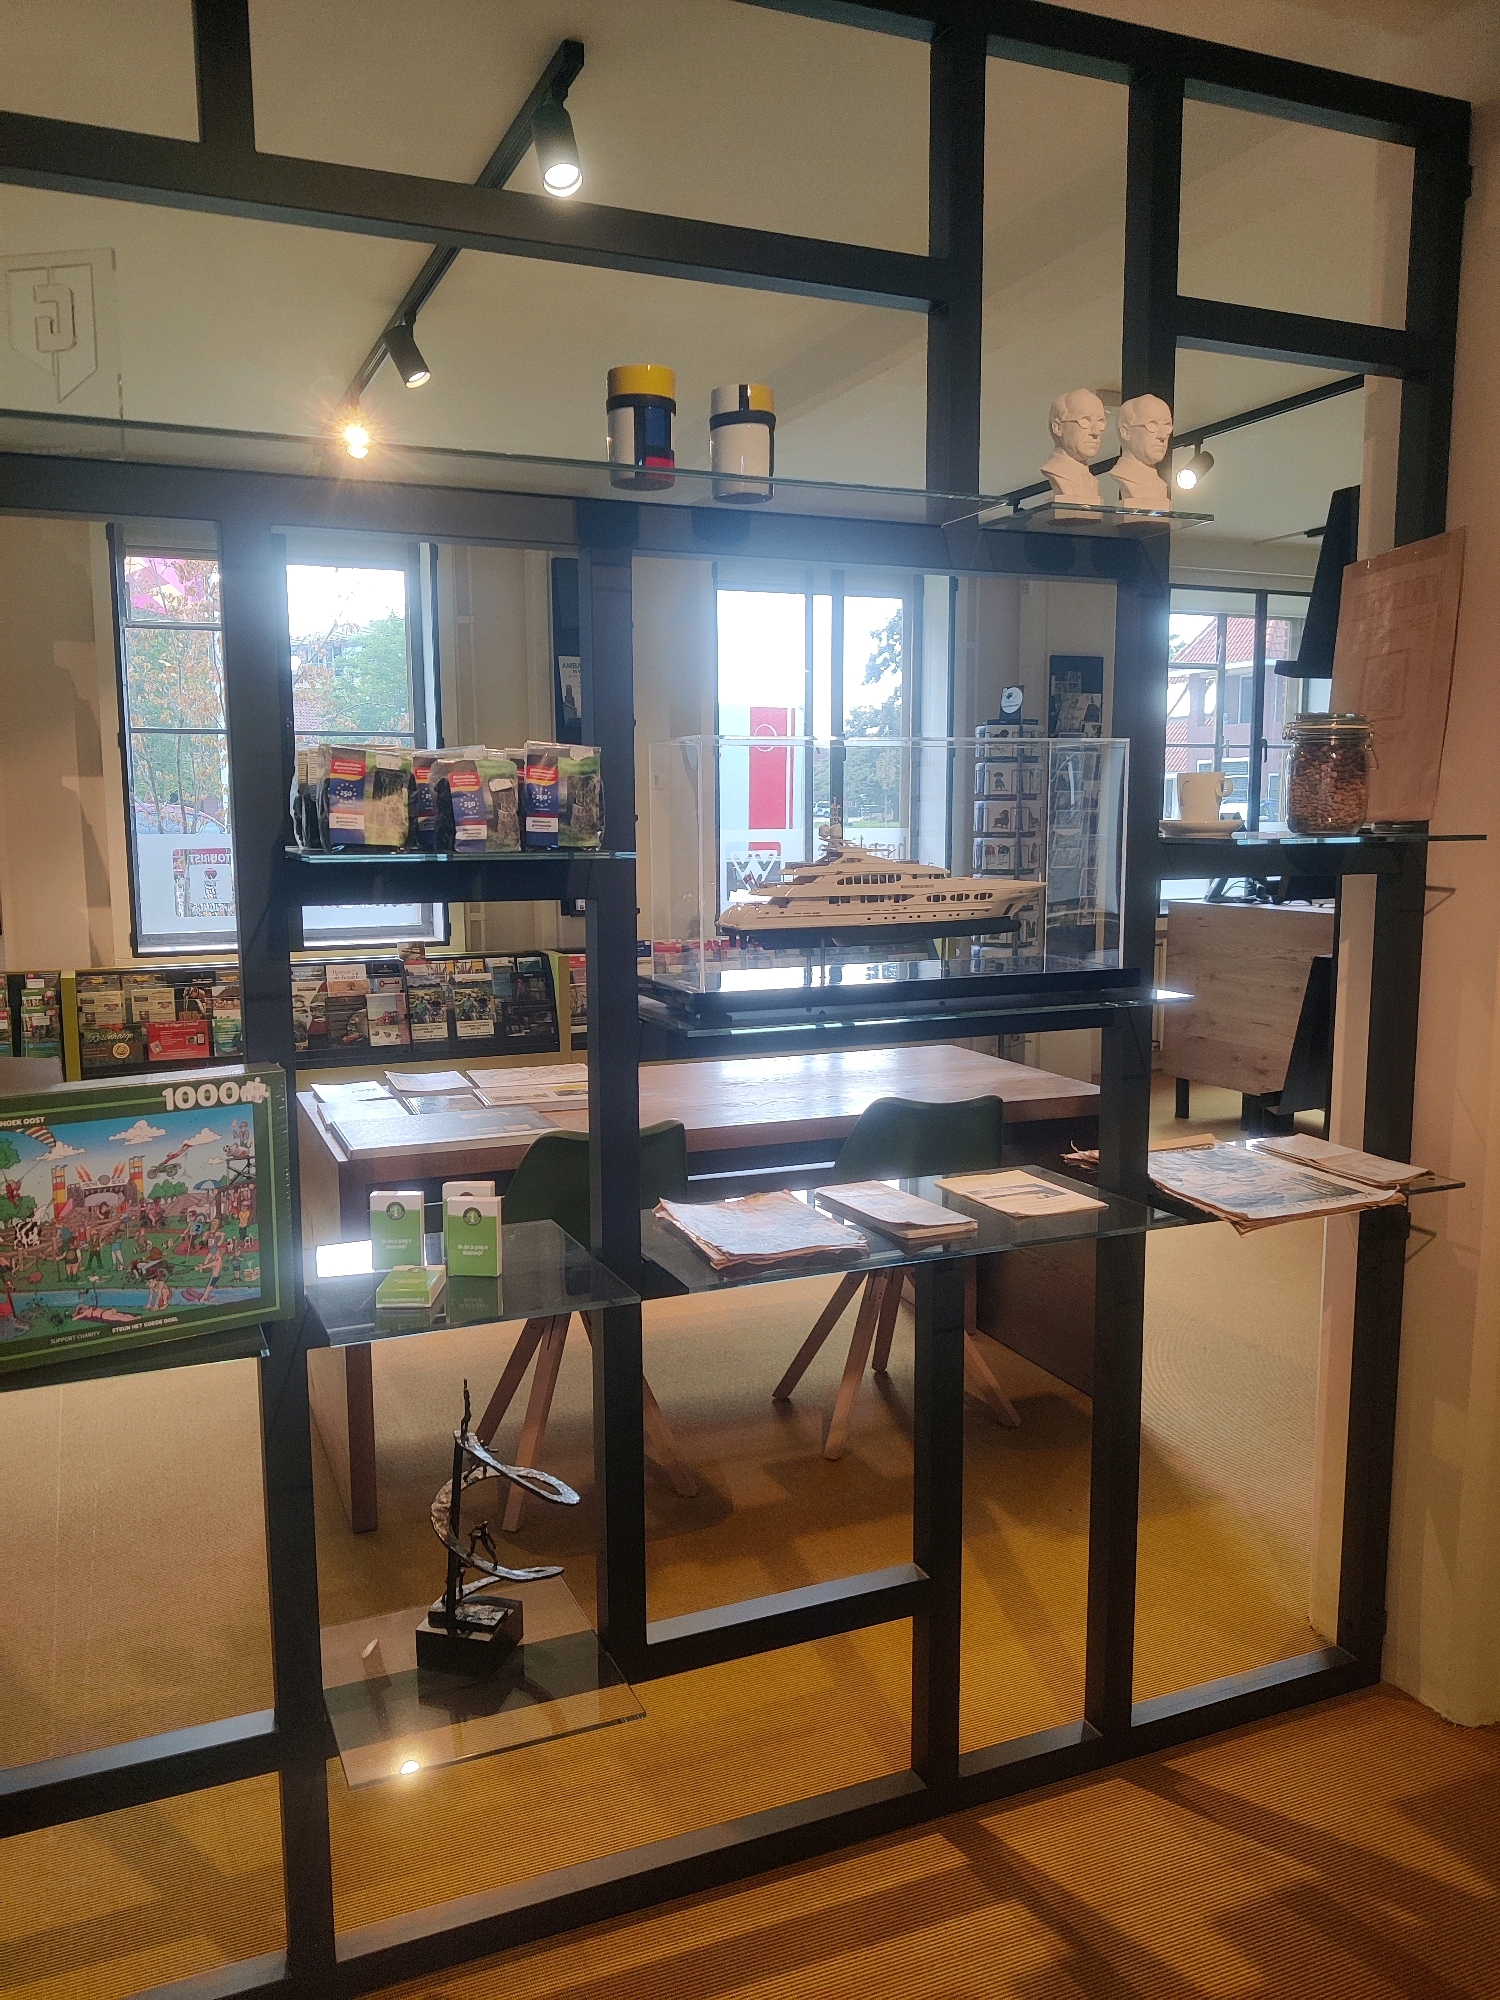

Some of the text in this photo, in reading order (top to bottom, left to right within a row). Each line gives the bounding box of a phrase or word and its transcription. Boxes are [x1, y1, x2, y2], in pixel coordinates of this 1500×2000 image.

[162, 1081, 241, 1111] 1000
[23, 1116, 45, 1125] OOST
[111, 1325, 131, 1334] STEUN
[131, 1322, 143, 1331] HET
[163, 1316, 179, 1325] DOEL
[50, 1331, 101, 1345] SUPPORT CHARITY
